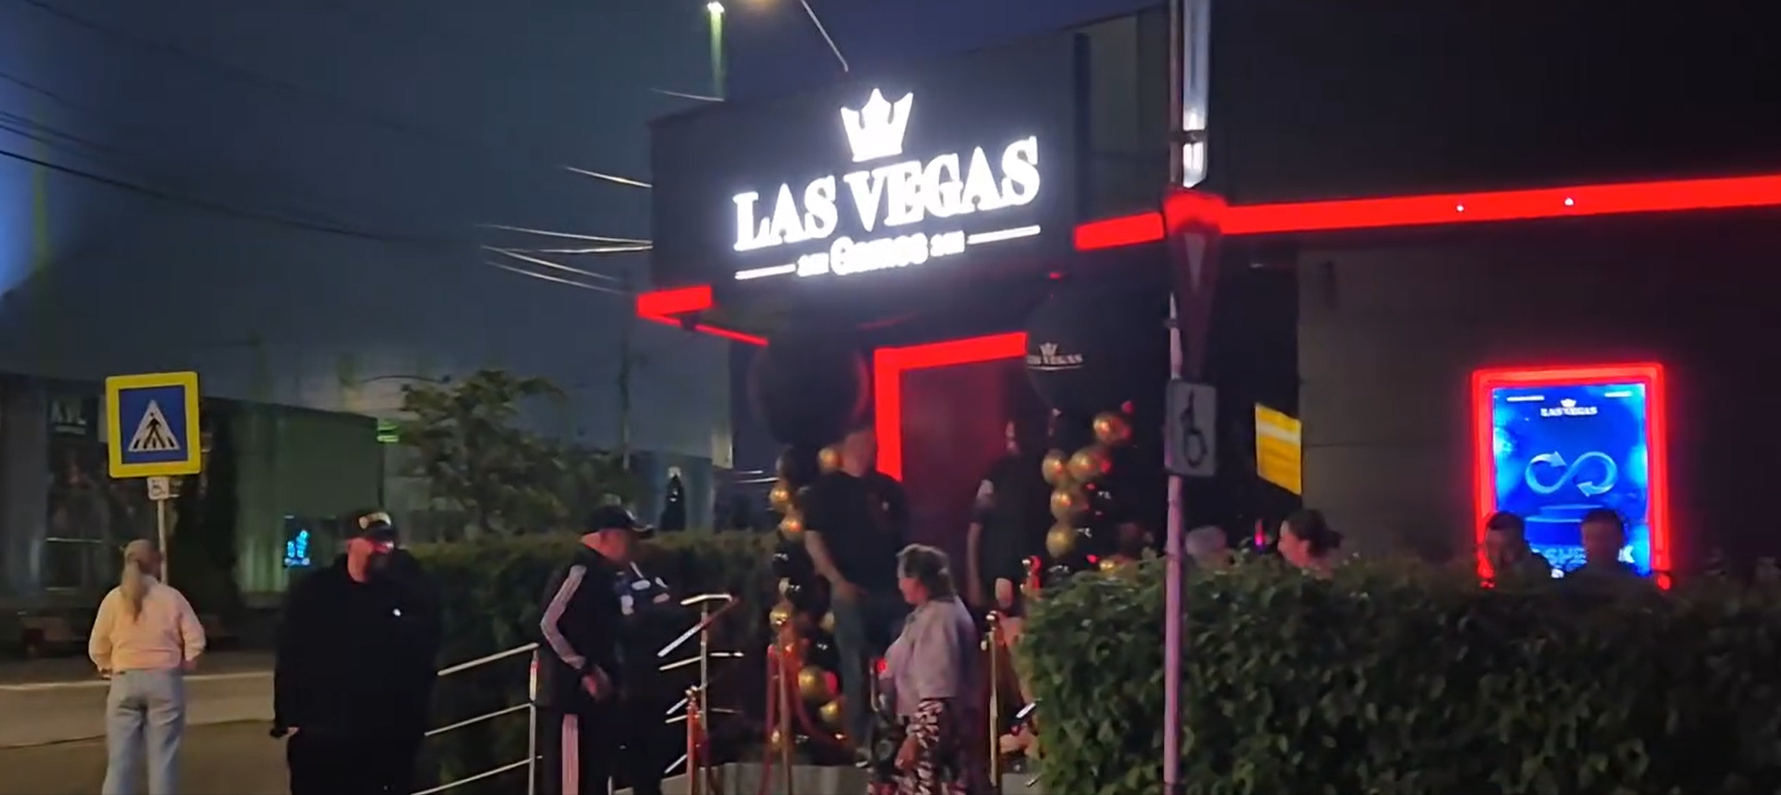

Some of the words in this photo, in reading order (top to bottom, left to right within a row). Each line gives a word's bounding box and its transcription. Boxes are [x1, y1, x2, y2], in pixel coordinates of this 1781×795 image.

[733, 175, 838, 251] LAS
[843, 135, 1040, 232] VEGAS
[1540, 407, 1562, 416] LAS
